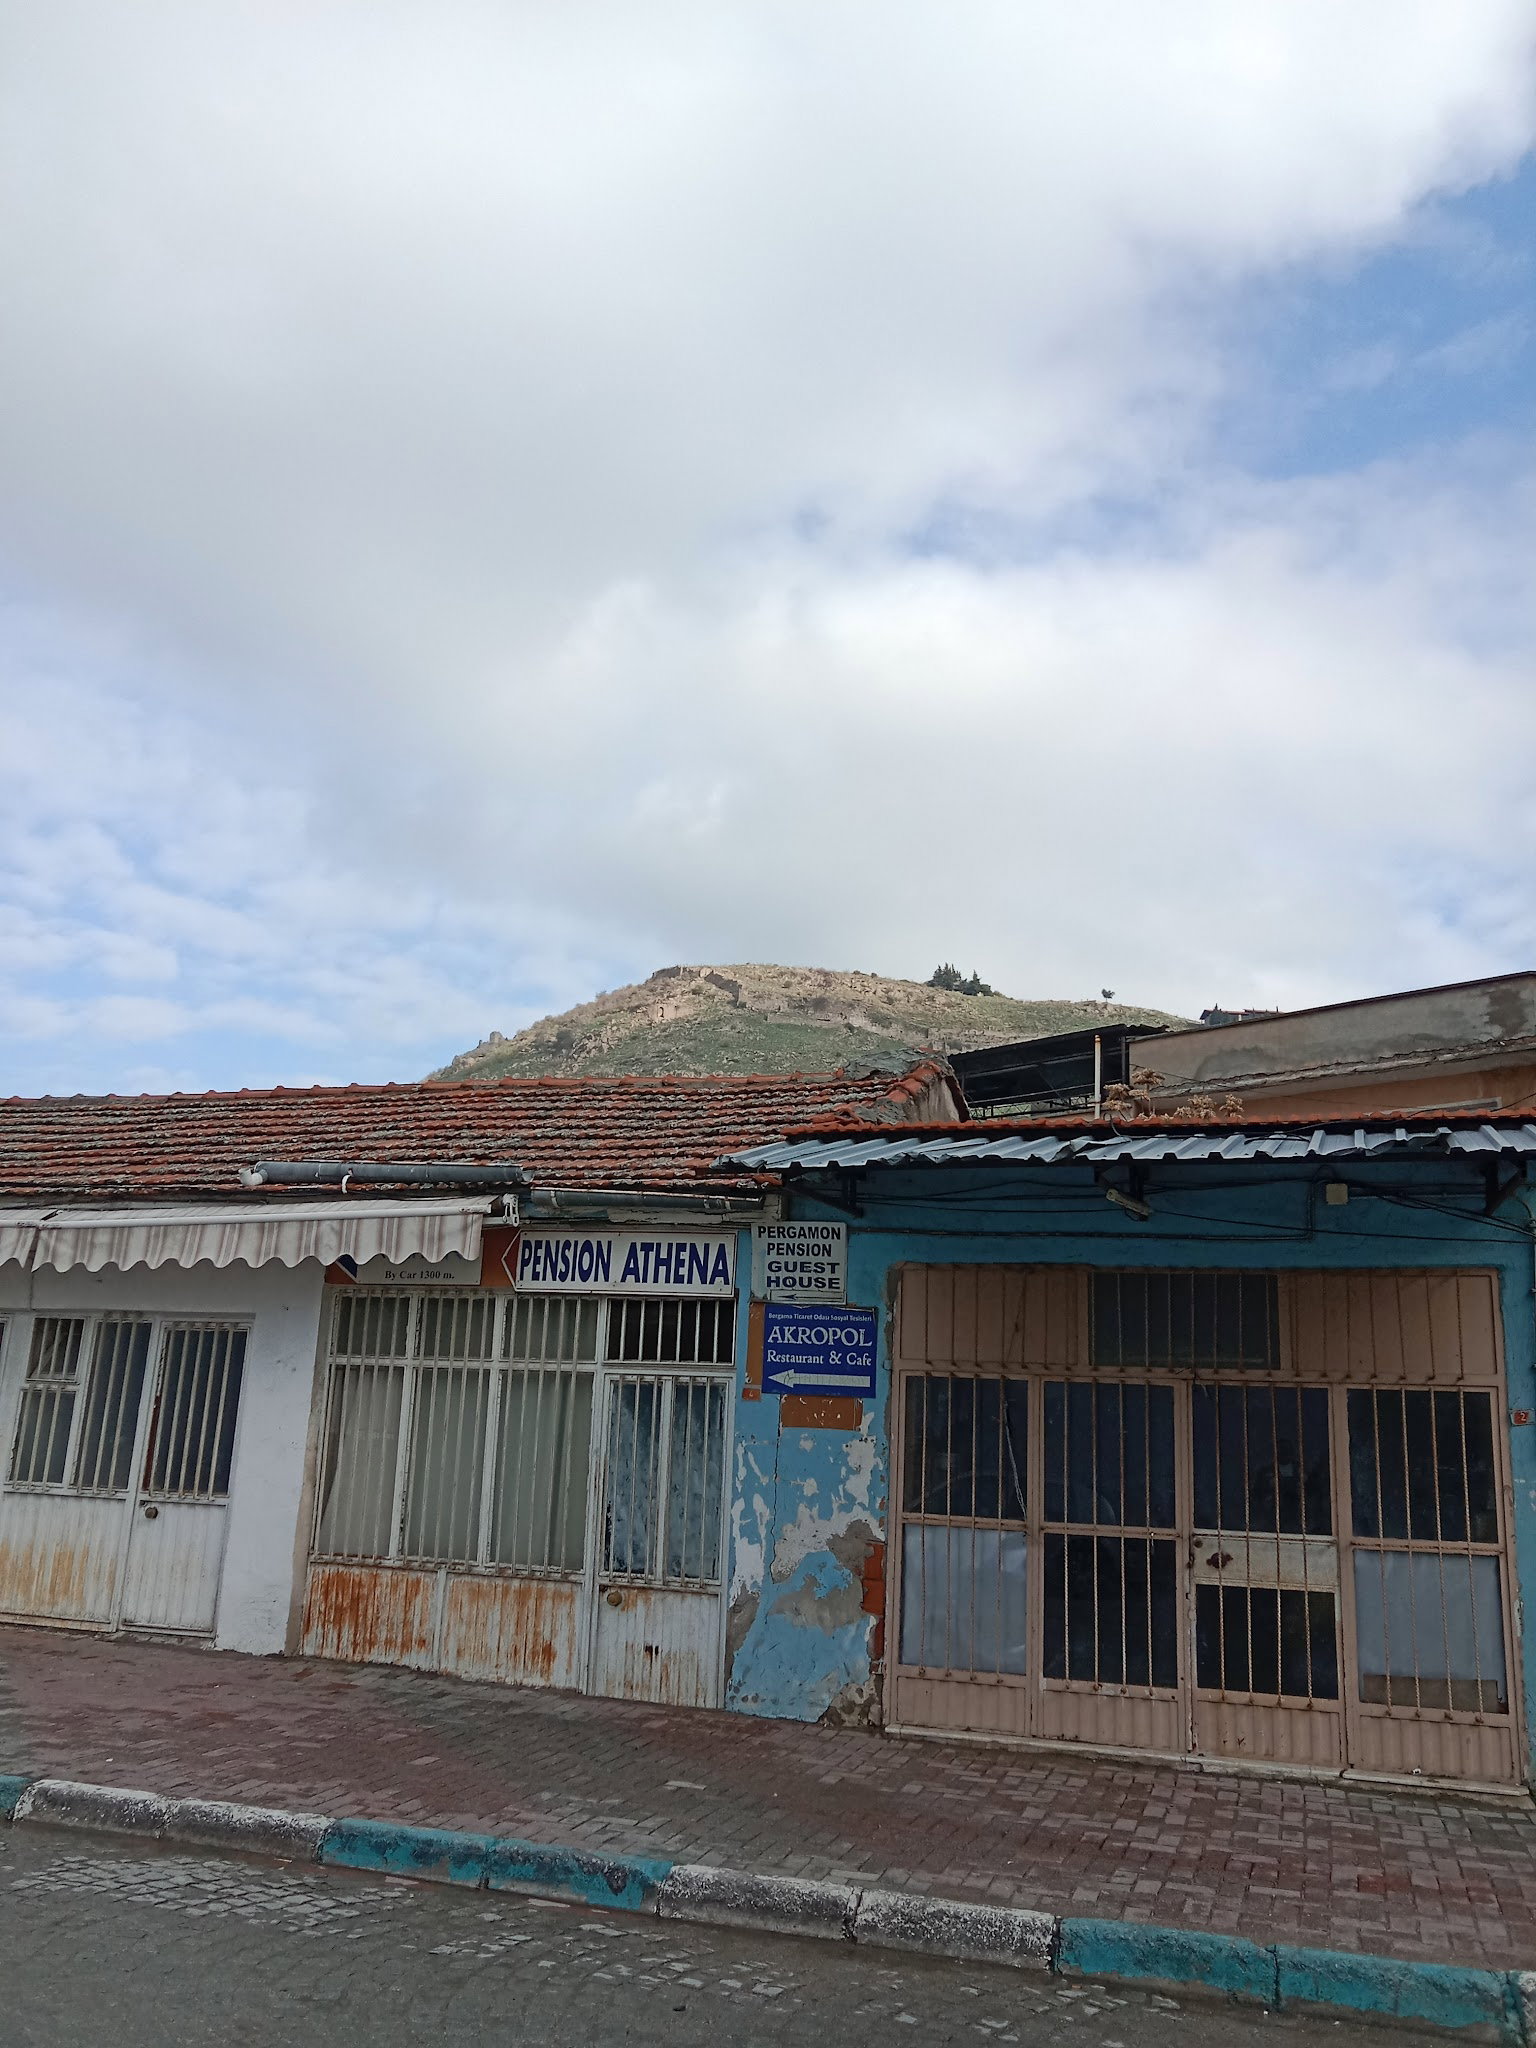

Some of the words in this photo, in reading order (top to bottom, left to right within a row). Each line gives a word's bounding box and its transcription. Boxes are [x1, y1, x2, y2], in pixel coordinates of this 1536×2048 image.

[757, 1225, 841, 1240] PERGAMON
[766, 1242, 832, 1257] PENSION
[520, 1239, 612, 1283] PENSION
[620, 1241, 730, 1286] ATHENA
[767, 1260, 840, 1274] GUEST
[384, 1270, 396, 1281] By
[399, 1270, 418, 1279] Car
[419, 1270, 441, 1279] 1300
[442, 1271, 455, 1279] m.
[766, 1275, 841, 1289] HOUSE
[768, 1312, 793, 1321] Bergama
[830, 1314, 849, 1322] Sosyal
[767, 1325, 873, 1347] AKROPOL
[766, 1349, 824, 1365] Restaurant
[829, 1350, 843, 1365] &
[846, 1352, 872, 1366] Cafe
[1520, 1412, 1527, 1421] 2
